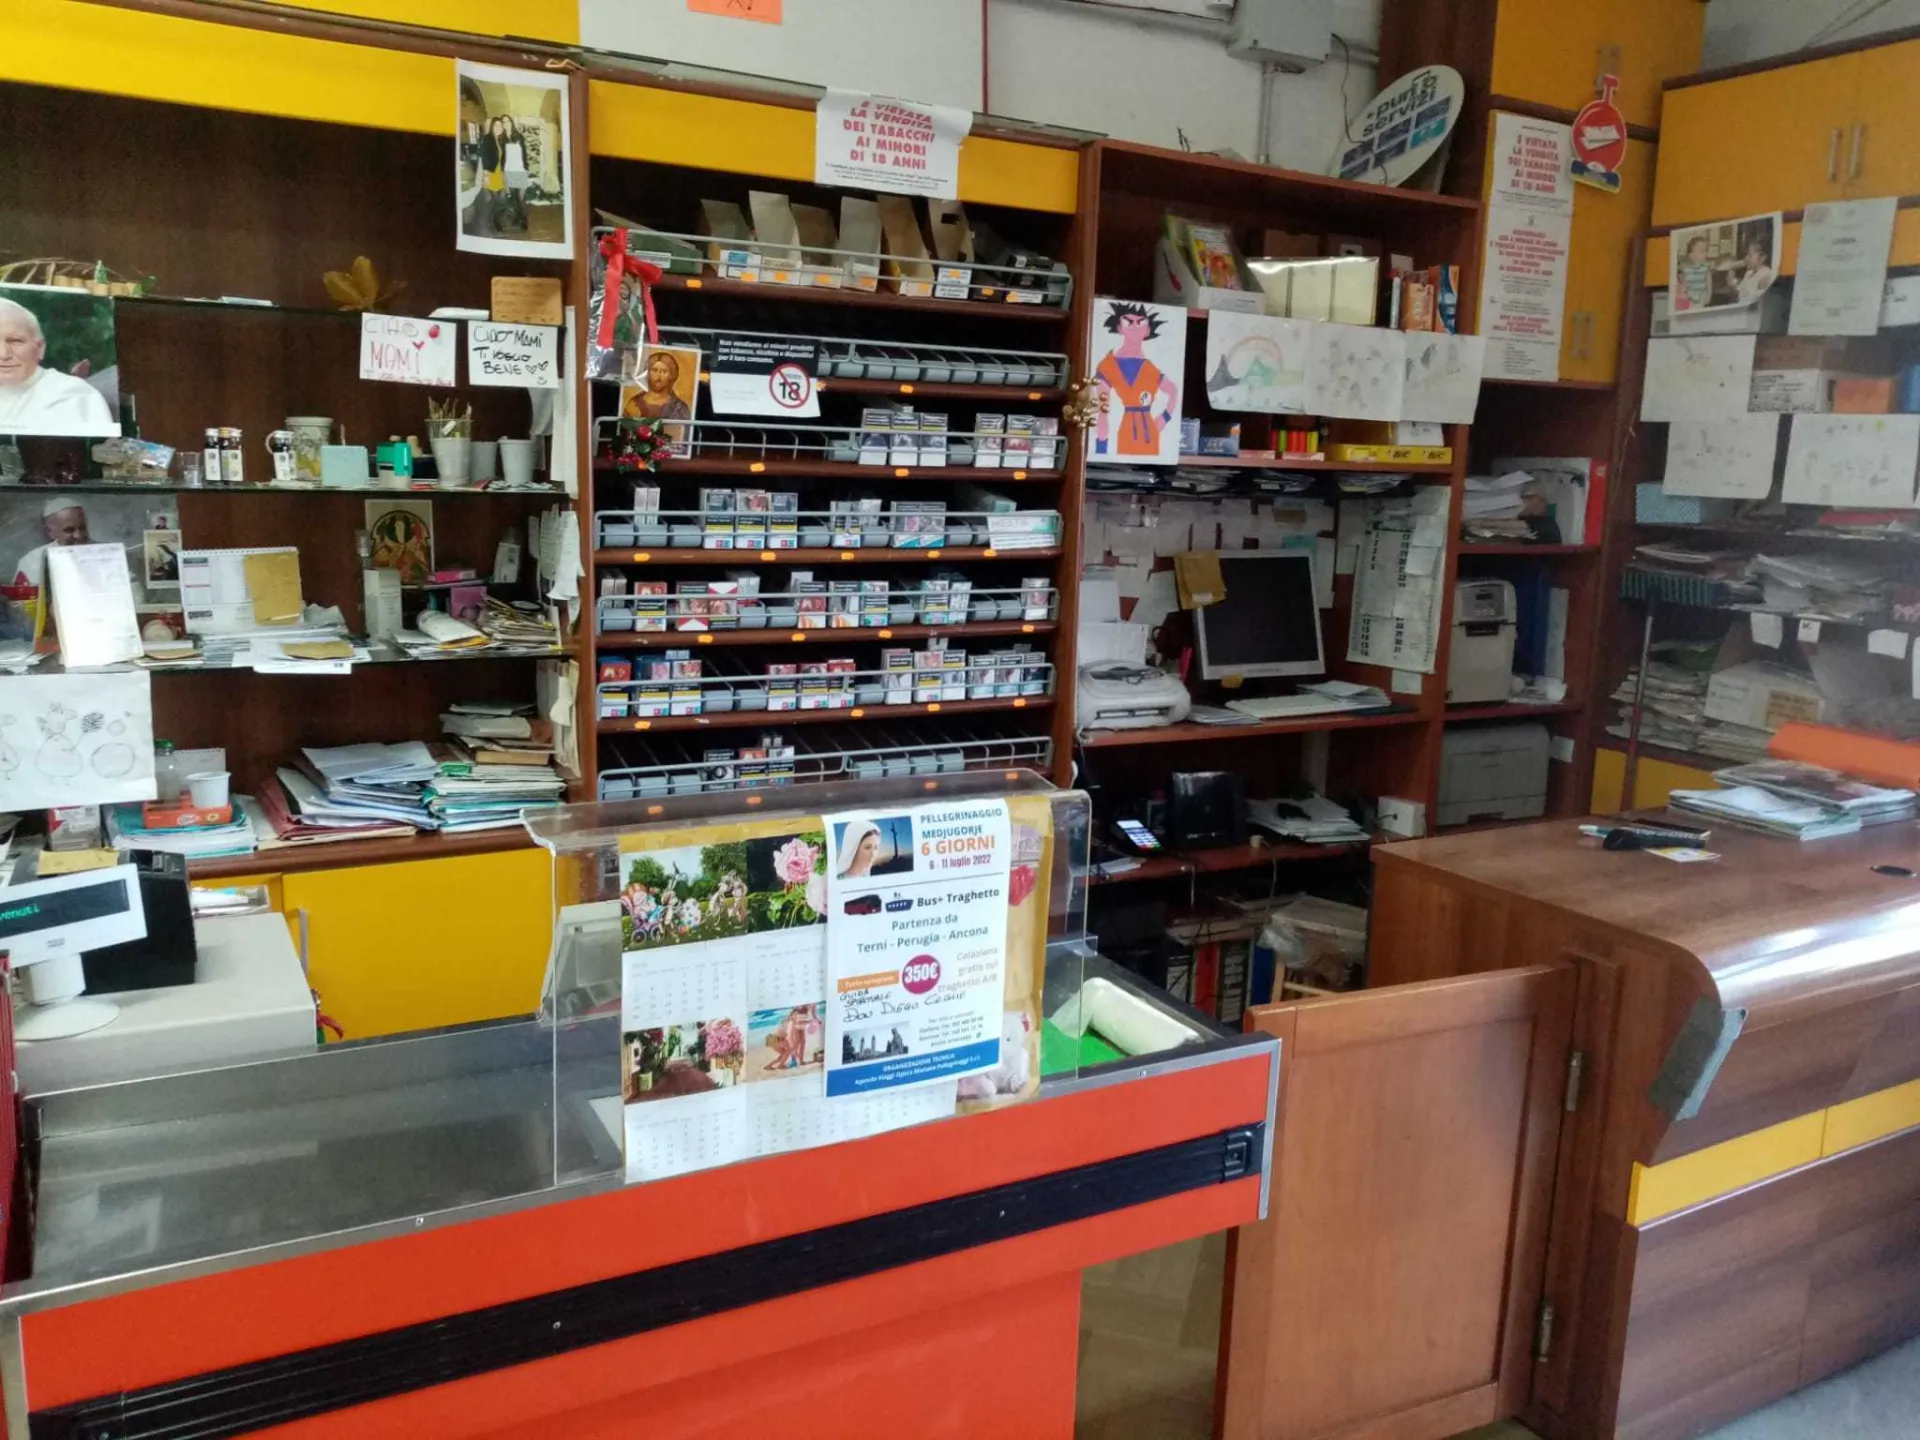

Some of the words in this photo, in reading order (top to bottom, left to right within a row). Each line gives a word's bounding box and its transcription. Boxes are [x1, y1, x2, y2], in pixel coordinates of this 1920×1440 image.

[850, 107, 867, 118] LA
[874, 111, 933, 130] VENDITA
[876, 103, 932, 124] VIETATA
[1363, 87, 1437, 138] servizi
[843, 119, 865, 133] DEI
[871, 123, 935, 144] TABACCHI
[856, 136, 870, 148] AI
[876, 139, 926, 157] MINORI
[850, 150, 864, 162] DI
[872, 153, 886, 164] 18
[892, 156, 926, 170] ANNI
[364, 319, 420, 337] CIAO
[483, 361, 522, 375] BENE
[779, 382, 800, 401] 18
[920, 808, 1002, 824] PELLEGRINAGGIO
[921, 824, 983, 840] MEDJUGORJE
[921, 842, 930, 856] 6
[935, 835, 995, 855] GIORNI
[929, 860, 935, 870] 6
[942, 859, 948, 869] 11
[950, 855, 971, 868] luglio
[972, 854, 991, 866] 2022
[917, 896, 943, 908] Bus+
[946, 889, 1000, 904] Traghetto
[892, 916, 941, 930] Partenza
[945, 914, 958, 923] da
[857, 942, 887, 953] Terni
[897, 933, 940, 947] Perugia
[949, 926, 989, 940] Ancona
[904, 962, 938, 984] 350€
[958, 963, 983, 977] gratis
[985, 960, 998, 970] sul
[881, 1002, 919, 1015] DIEGO
[883, 1057, 931, 1072] ORGANIZZAZIONE
[895, 1070, 913, 1079] Opera
